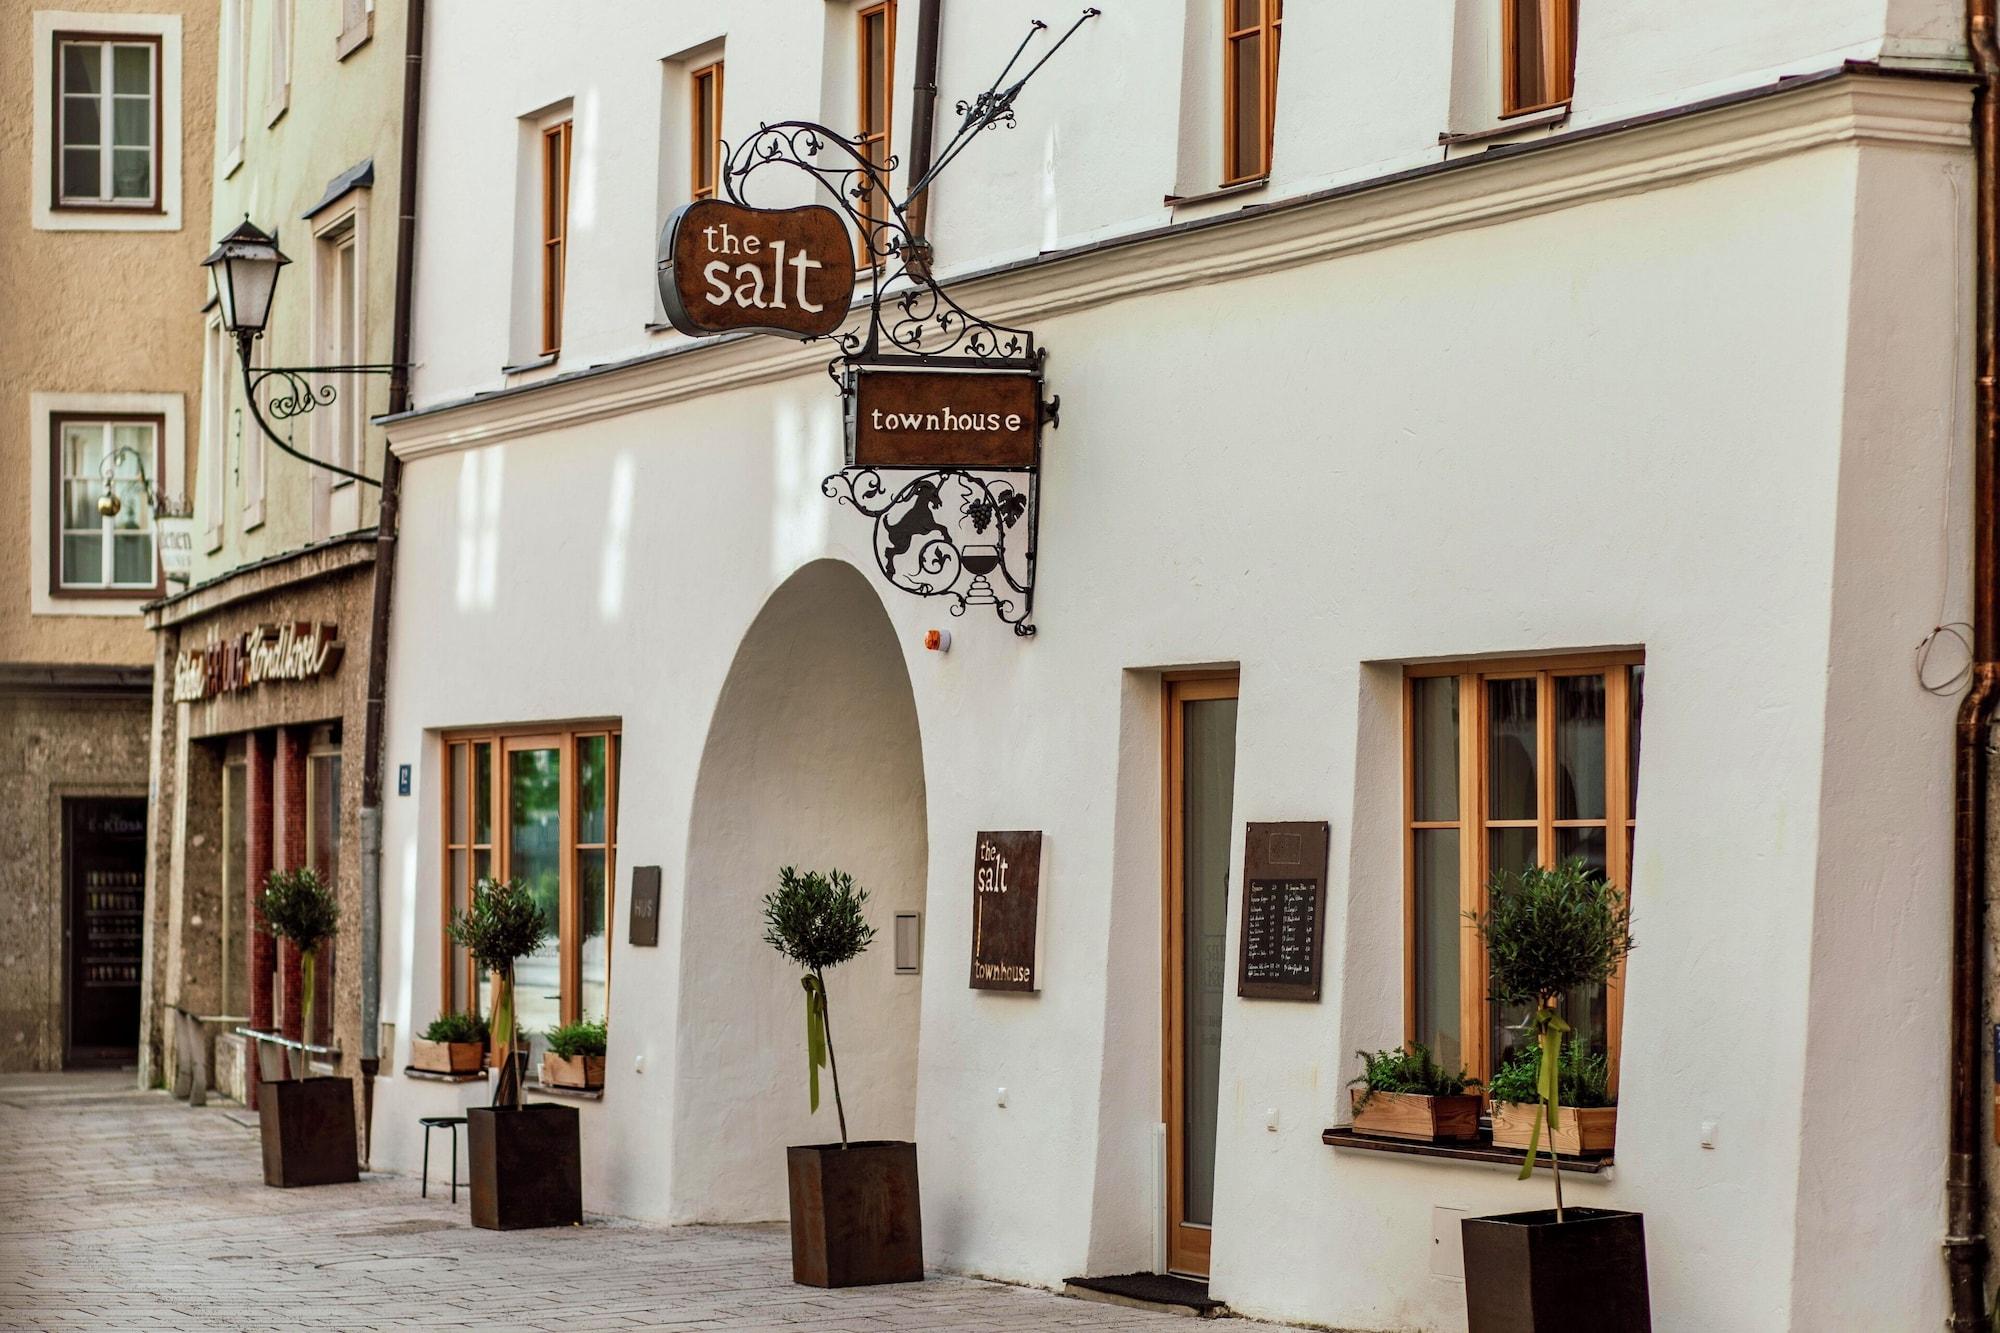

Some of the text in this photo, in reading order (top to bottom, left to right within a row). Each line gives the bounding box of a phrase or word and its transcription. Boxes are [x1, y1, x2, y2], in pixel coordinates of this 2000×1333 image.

[703, 223, 761, 255] the
[703, 240, 823, 313] salt
[871, 406, 1021, 431] townhouse
[980, 841, 996, 862] the
[978, 853, 1009, 893] salt
[974, 960, 1031, 982] townhouse
